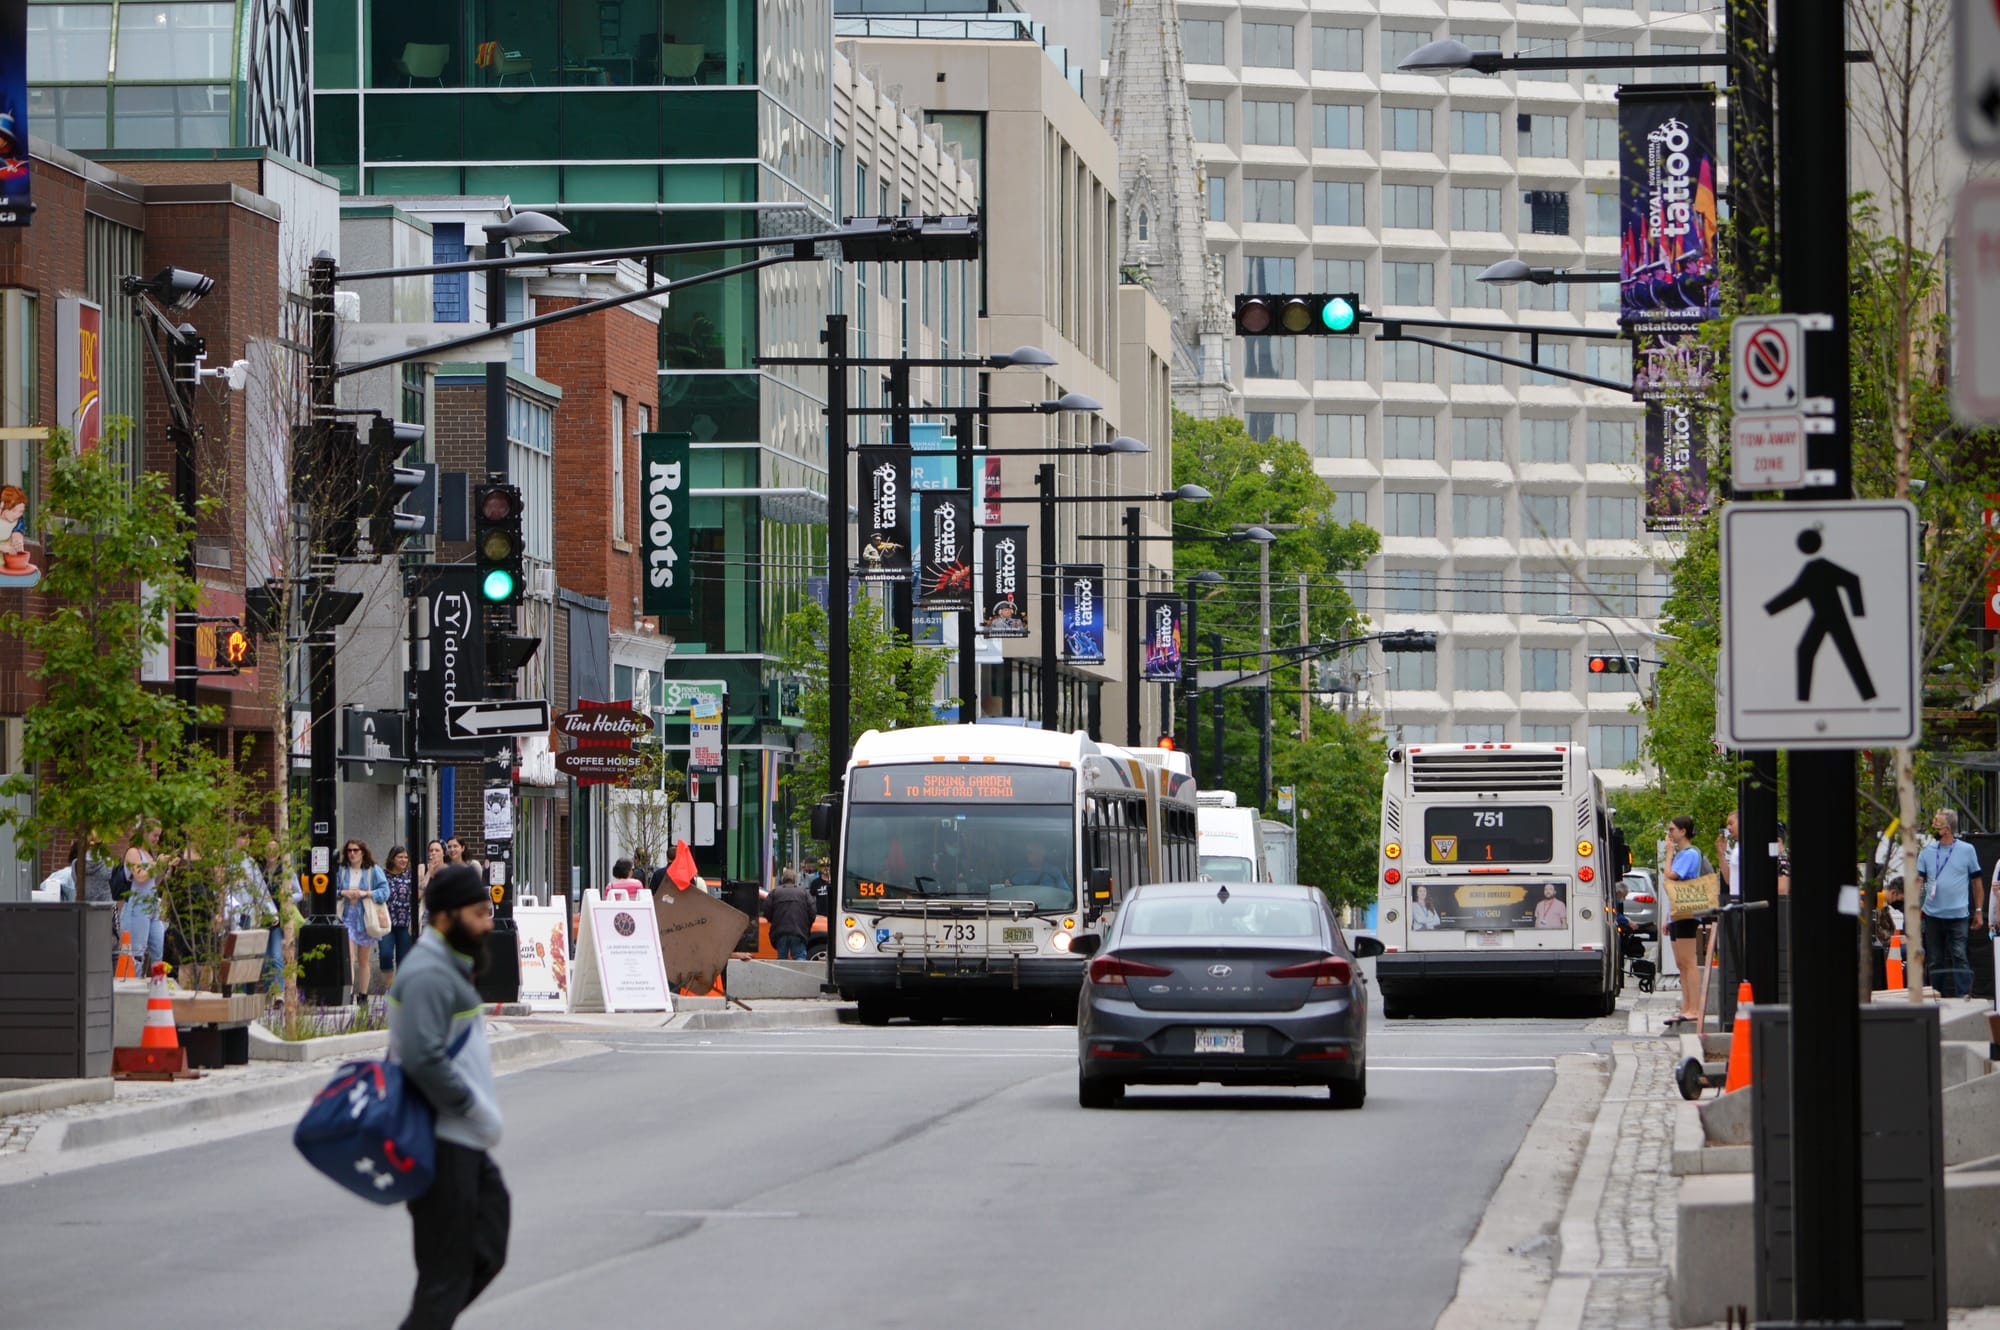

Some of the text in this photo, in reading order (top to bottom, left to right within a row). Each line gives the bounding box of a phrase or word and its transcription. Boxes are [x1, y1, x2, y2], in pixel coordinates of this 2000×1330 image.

[1648, 143, 1662, 238] ROYAL NOVA SCOTIA
[1663, 129, 1690, 237] tattoo
[1634, 323, 1699, 331] nstattoo.c
[80, 328, 98, 382] IBC
[1753, 456, 1784, 472] ZONE
[881, 468, 896, 529] tattoo
[650, 461, 682, 588] Roots
[942, 507, 955, 563] tattoo
[1003, 542, 1016, 594] tattoo
[1081, 580, 1093, 626] tattoo
[1161, 608, 1172, 648] tattoo
[434, 591, 472, 733] (FY)idocto
[564, 713, 647, 732] Tim Hortons
[566, 757, 640, 766] COFFEE HOUSE
[884, 775, 892, 797] 1
[906, 786, 919, 797] TO
[923, 787, 974, 798] MUMFORD
[924, 776, 1012, 787] SPRING GARDEN
[1473, 811, 1504, 827] 751
[1485, 844, 1493, 860] 1
[859, 882, 885, 897] 514
[943, 924, 976, 941] 733
